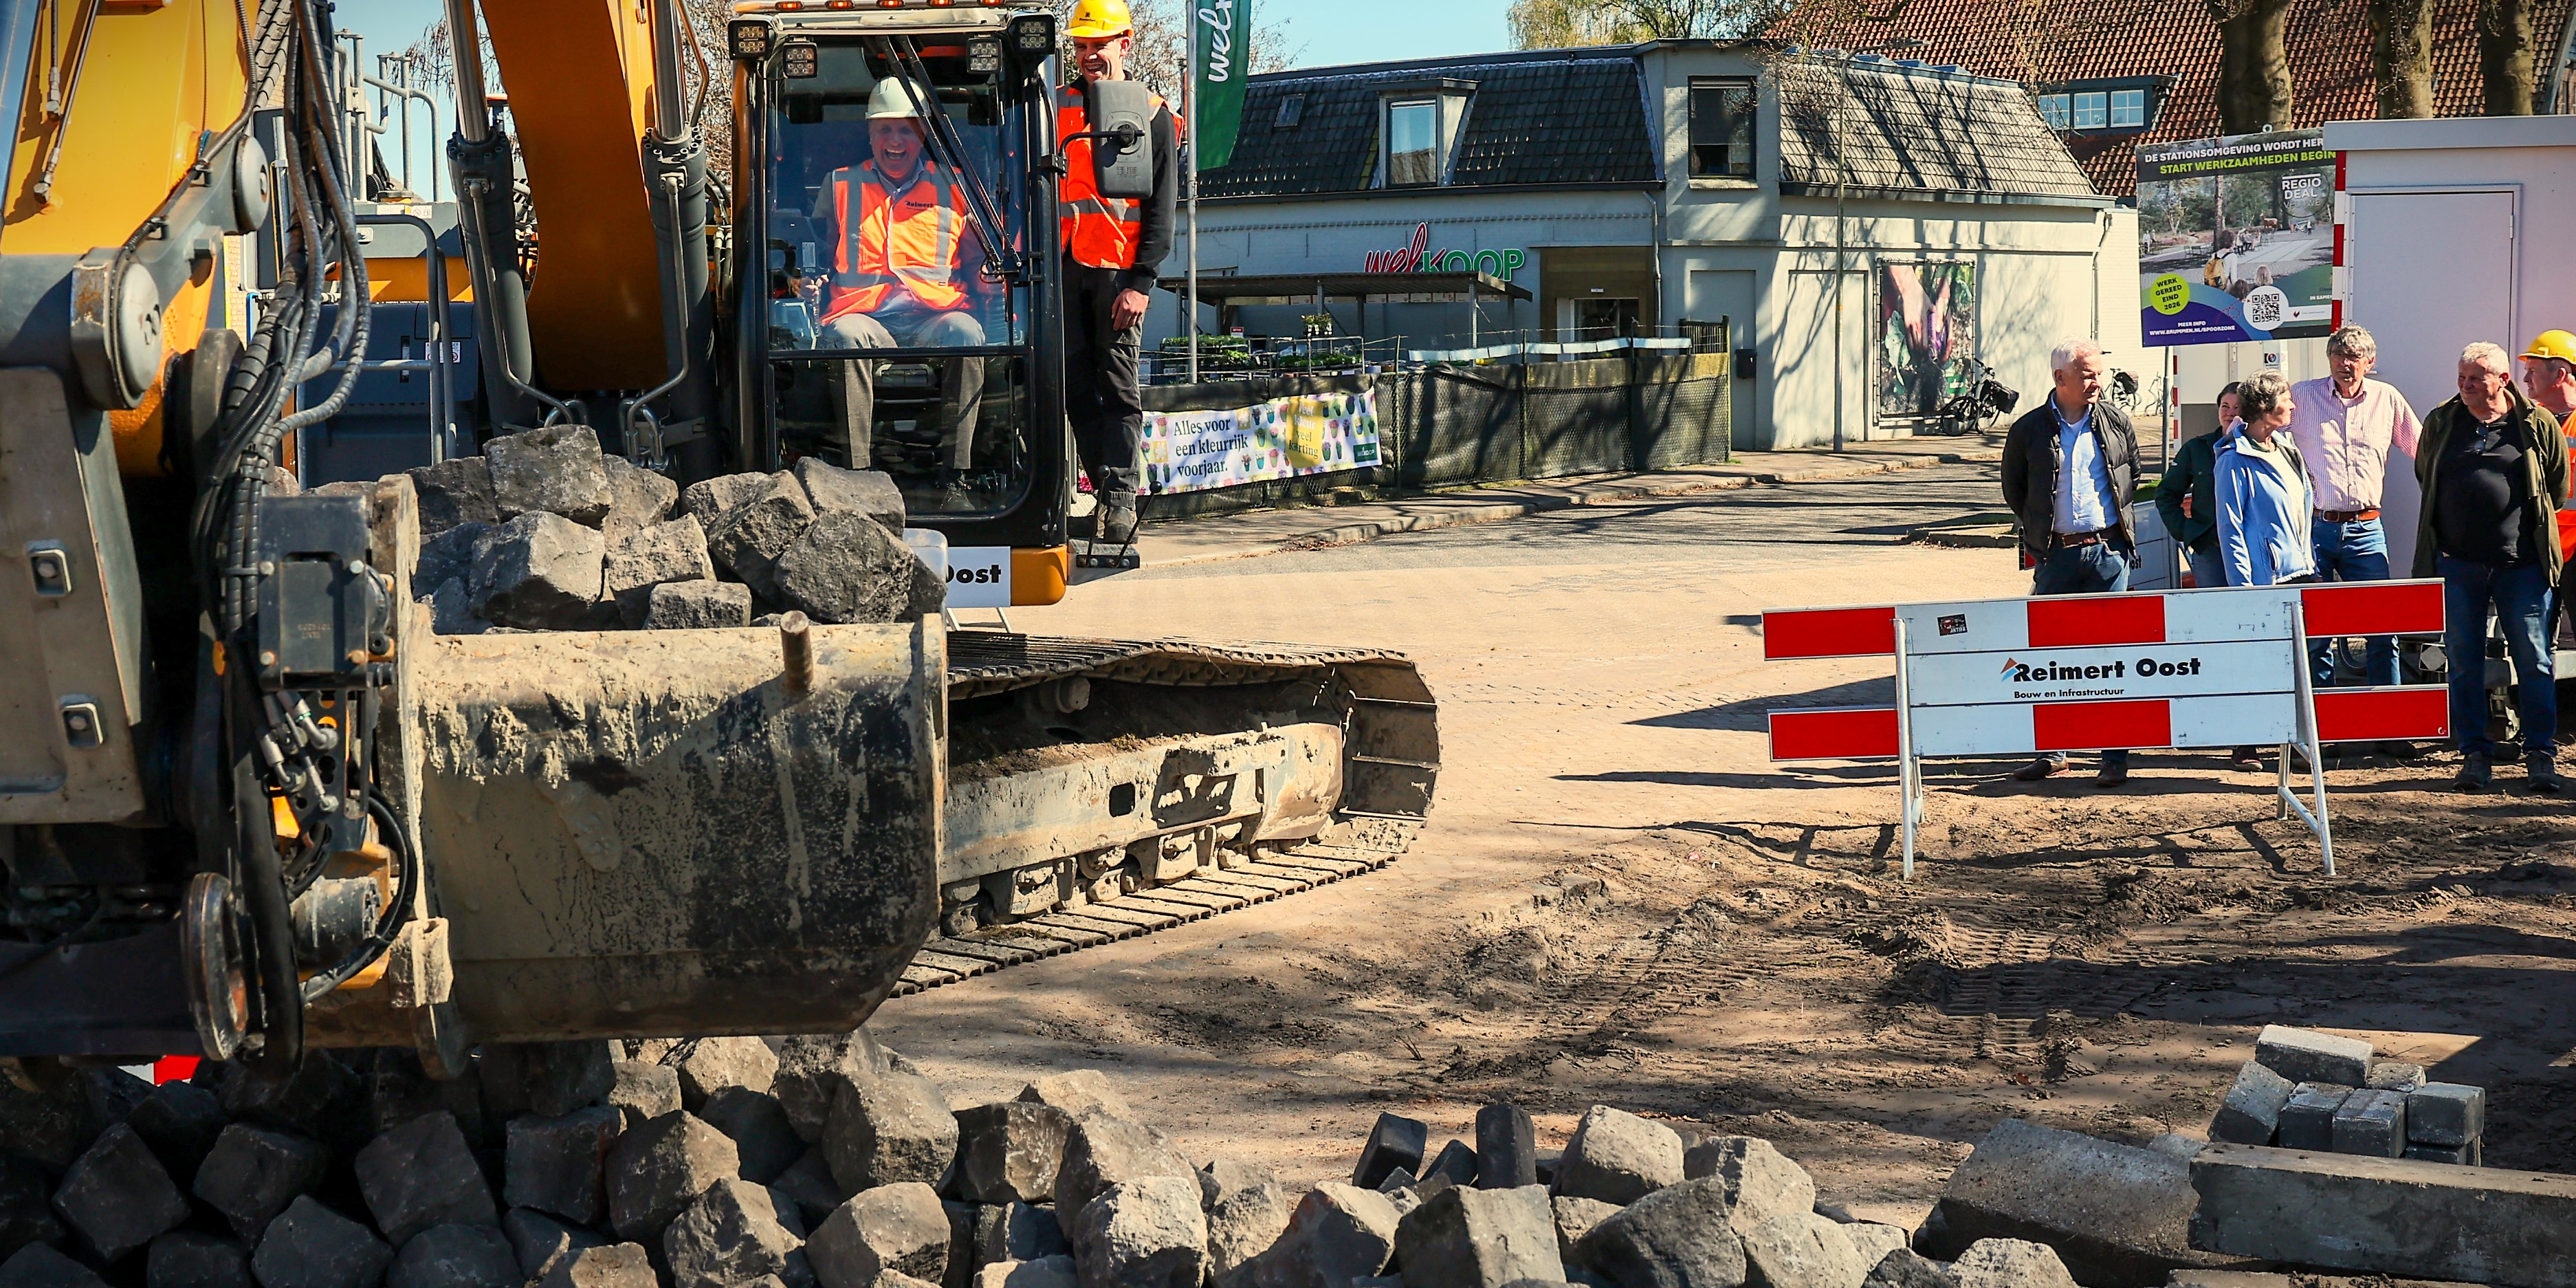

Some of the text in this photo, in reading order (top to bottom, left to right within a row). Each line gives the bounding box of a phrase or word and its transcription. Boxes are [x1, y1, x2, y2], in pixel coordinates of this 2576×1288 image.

[2145, 154, 2158, 163] DE
[2160, 144, 2261, 162] STATIONSOMGEVING
[2262, 140, 2301, 152] WORDT
[2160, 162, 2193, 174] START
[2194, 154, 2300, 171] WERKZAAMHEDEN
[2282, 177, 2322, 190] REGIO
[2284, 188, 2318, 200] DEAL
[2157, 278, 2177, 287] WERK
[2155, 285, 2182, 296] GEREED
[2162, 294, 2179, 303] EIND
[2164, 301, 2181, 310] 2026
[2149, 325, 2236, 336] WWW.BRUMMEN.NL/SPOORZONE
[1174, 419, 1231, 436] Alles voor
[1297, 430, 1312, 442] veel
[1176, 434, 1248, 457] een kleurrijk
[1177, 459, 1228, 478] voorjaar.
[2130, 555, 2142, 570] ost
[2013, 657, 2201, 682] Reimert Oost
[2014, 690, 2041, 699] Bouw
[2059, 688, 2124, 697] Infrastructuur
